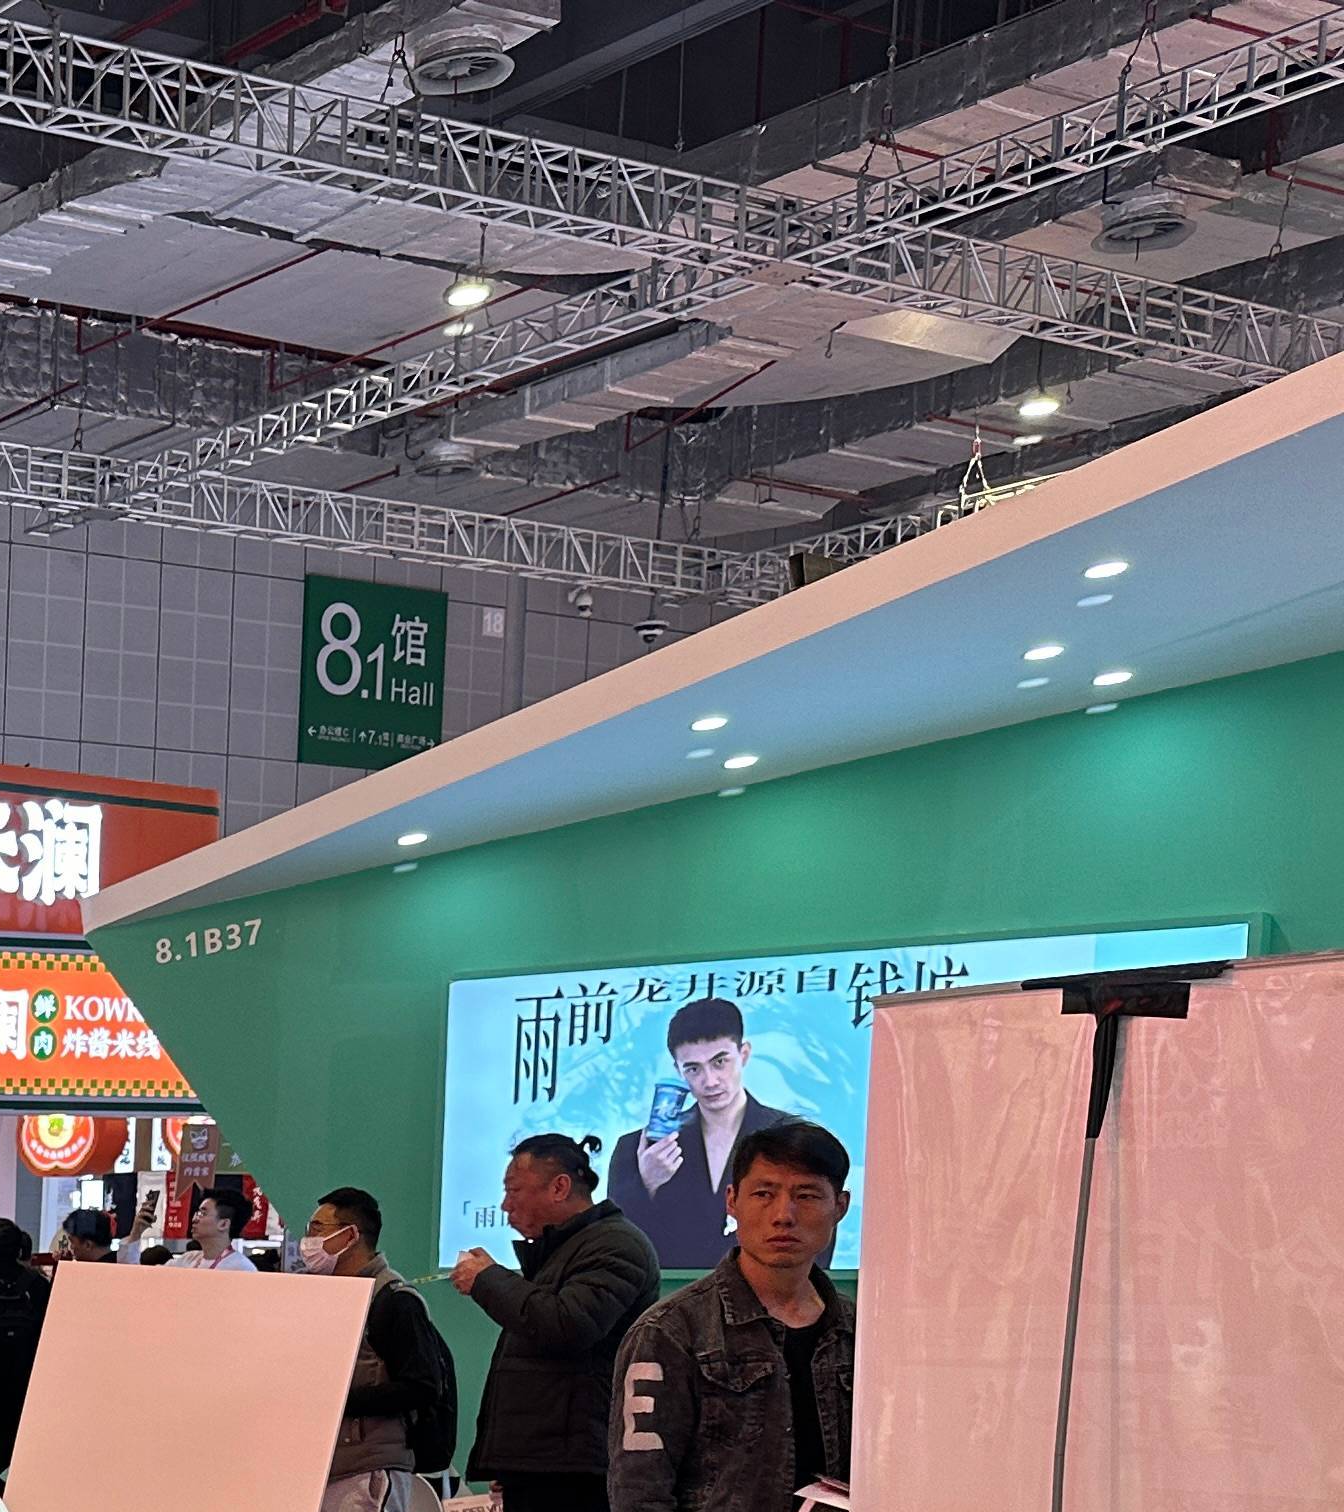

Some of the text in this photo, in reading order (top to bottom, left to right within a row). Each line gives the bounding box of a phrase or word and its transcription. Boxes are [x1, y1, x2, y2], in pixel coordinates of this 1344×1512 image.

[484, 611, 504, 634] 18
[316, 601, 429, 700] 8.1 馆
[390, 677, 435, 706] Hall
[154, 918, 264, 966] 8.1B37
[60, 1027, 161, 1060] 炸酱米线
[623, 1362, 664, 1451] E
